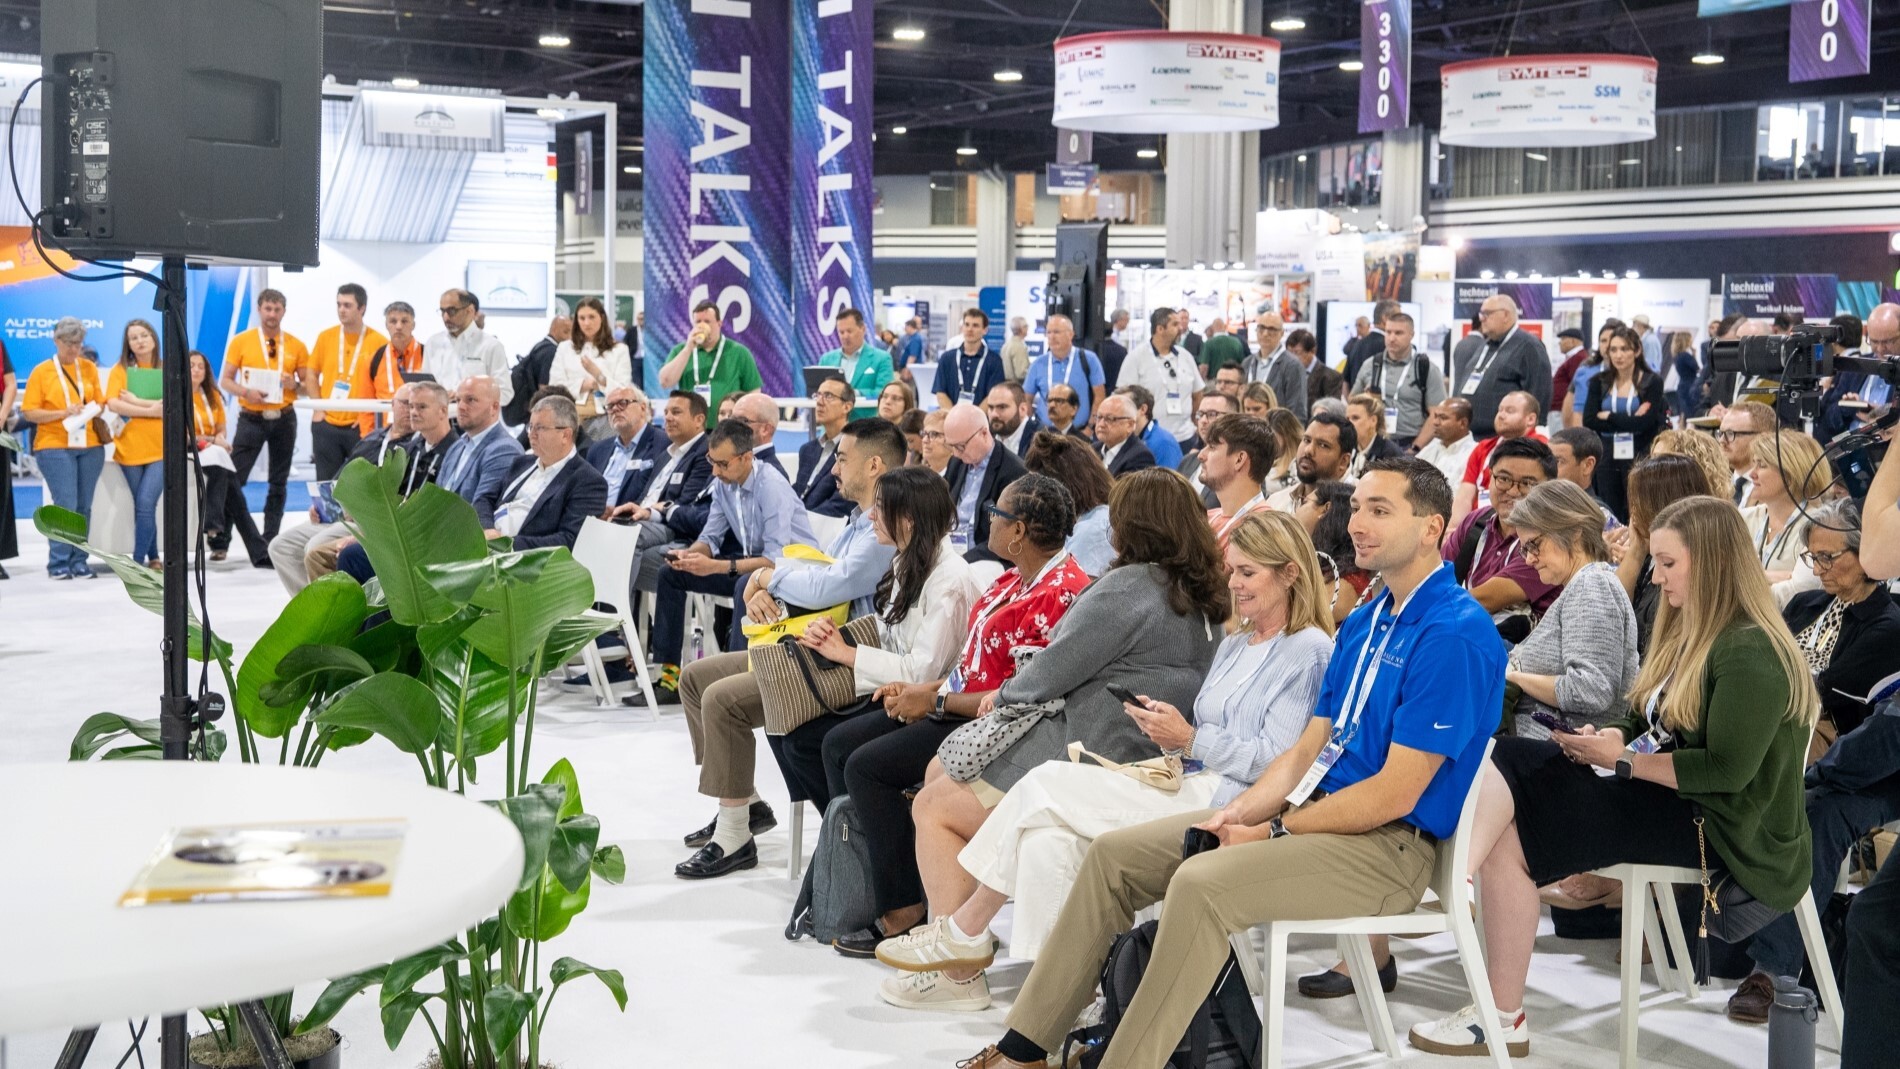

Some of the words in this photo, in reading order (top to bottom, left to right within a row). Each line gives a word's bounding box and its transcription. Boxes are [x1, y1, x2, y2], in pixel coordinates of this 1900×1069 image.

[1187, 43, 1264, 62] SYMTECH
[1377, 12, 1391, 118] 3300
[1498, 65, 1590, 81] SYMTECH
[1594, 85, 1621, 98] SSM
[689, 55, 752, 334] TALKS
[816, 50, 852, 336] TALKS
[1730, 281, 1774, 293] techtextil
[1755, 304, 1782, 314] Tarikul
[1783, 304, 1805, 314] Islam
